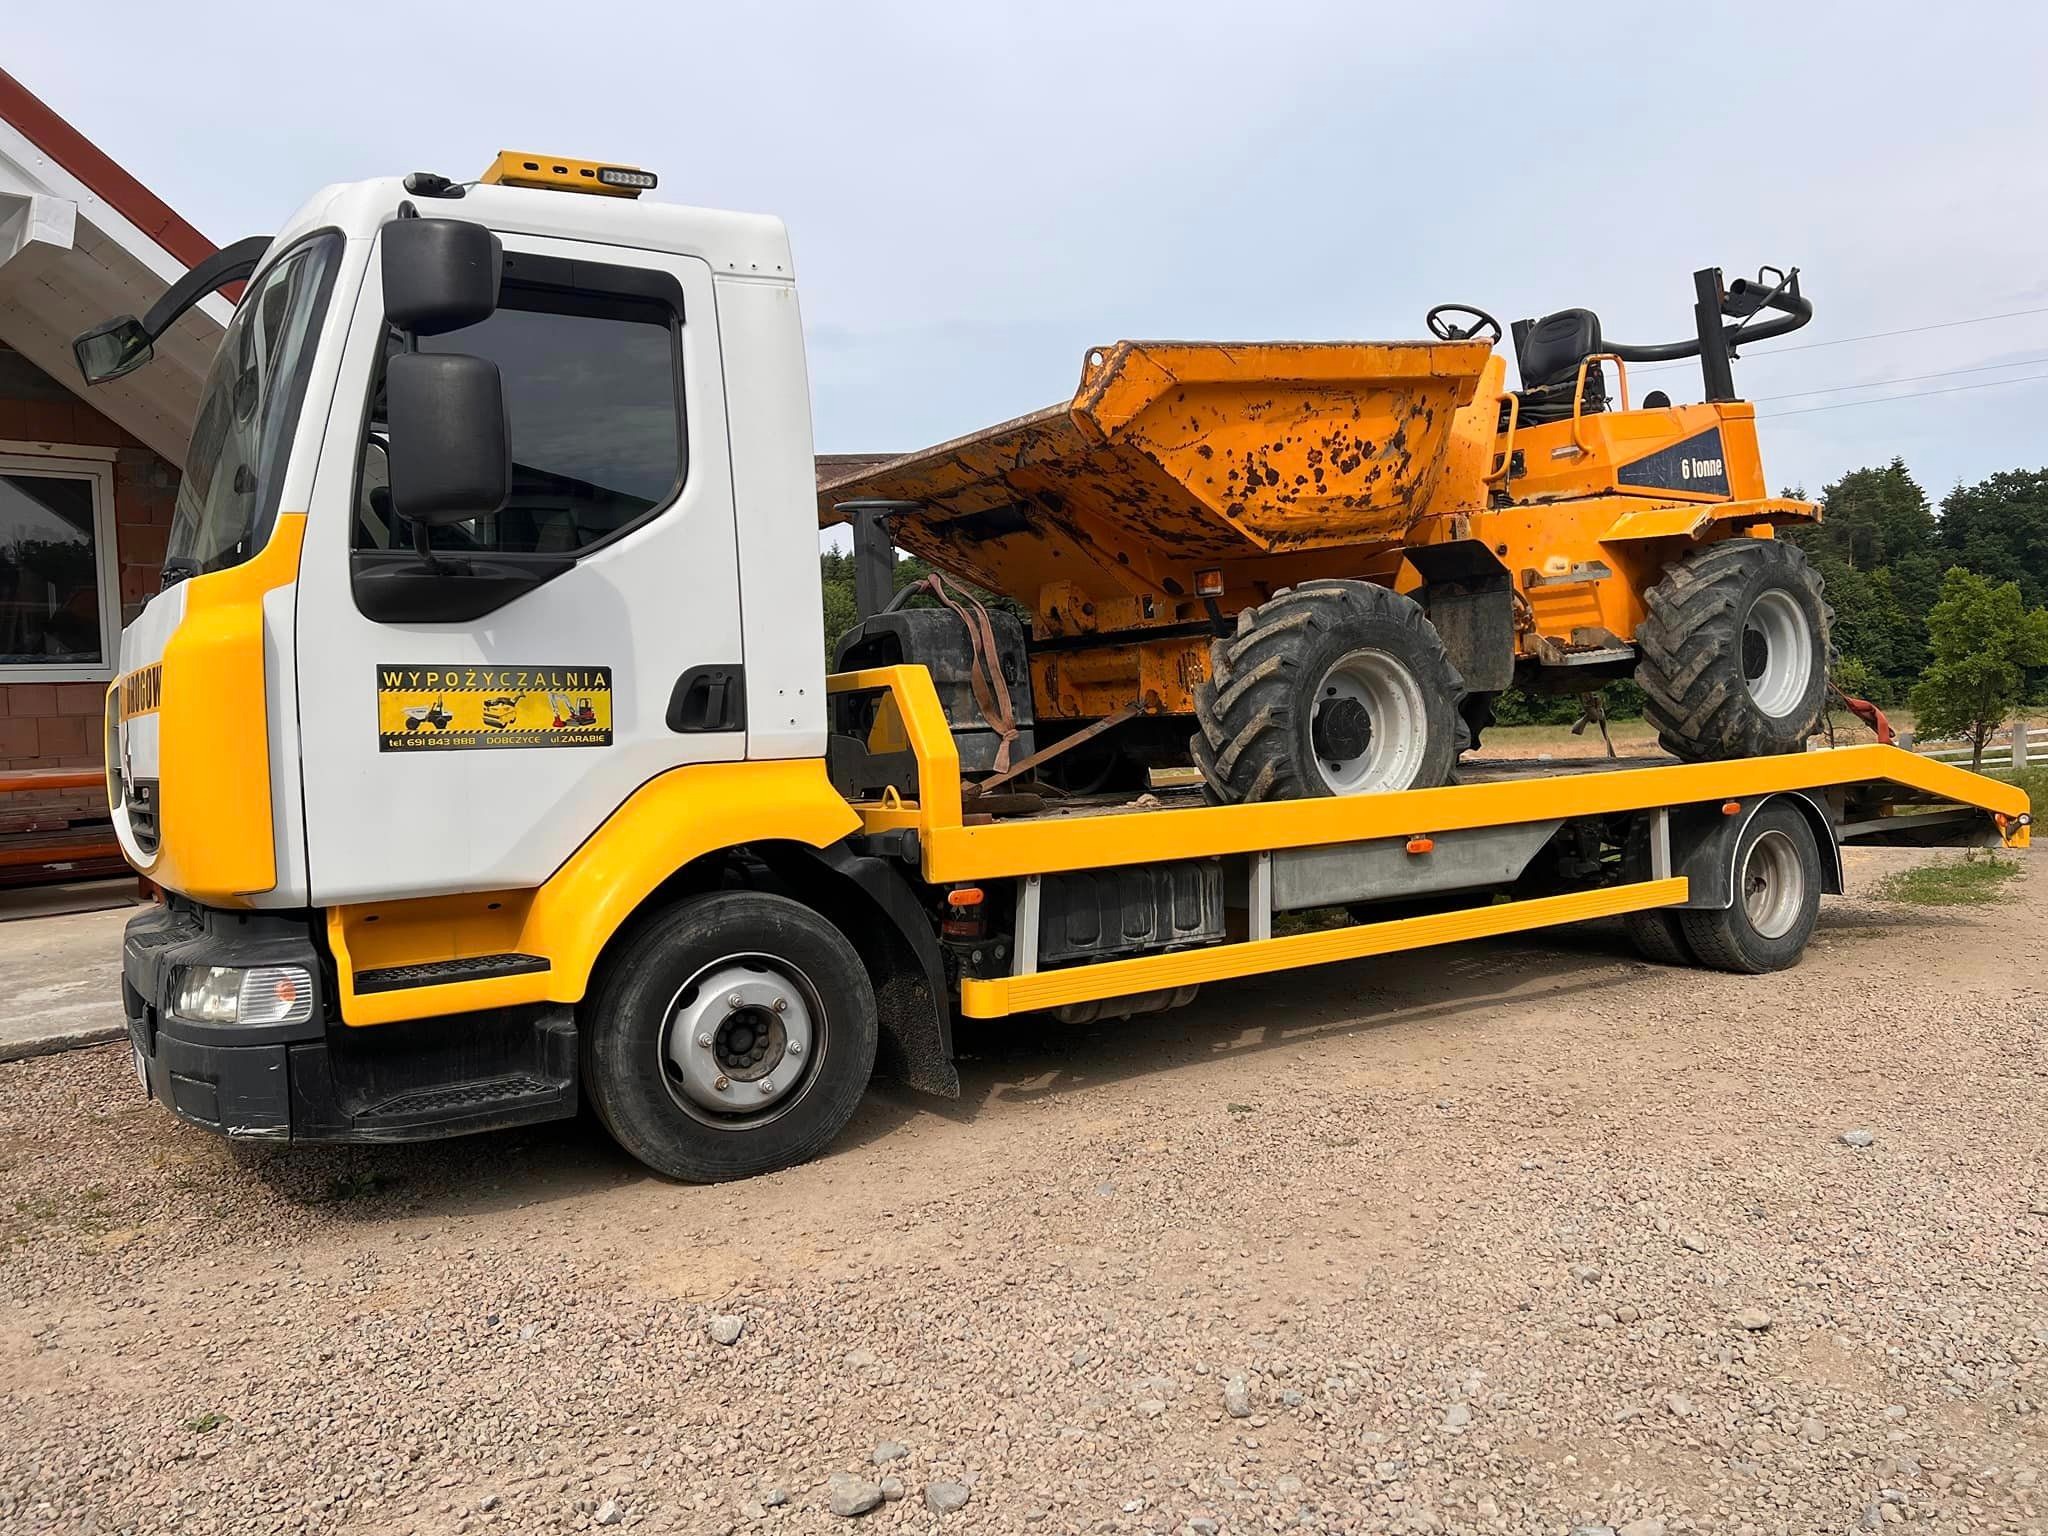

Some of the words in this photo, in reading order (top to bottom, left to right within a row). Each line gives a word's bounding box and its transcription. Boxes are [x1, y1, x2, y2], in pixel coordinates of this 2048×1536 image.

[1681, 459, 1690, 480] 6
[1692, 458, 1722, 478] tonne
[383, 668, 606, 687] WYPOŻYCZALNIA
[407, 738, 425, 747] 691
[428, 738, 450, 746] 843
[453, 737, 476, 745] 888
[486, 736, 541, 745] DOBCZYCE
